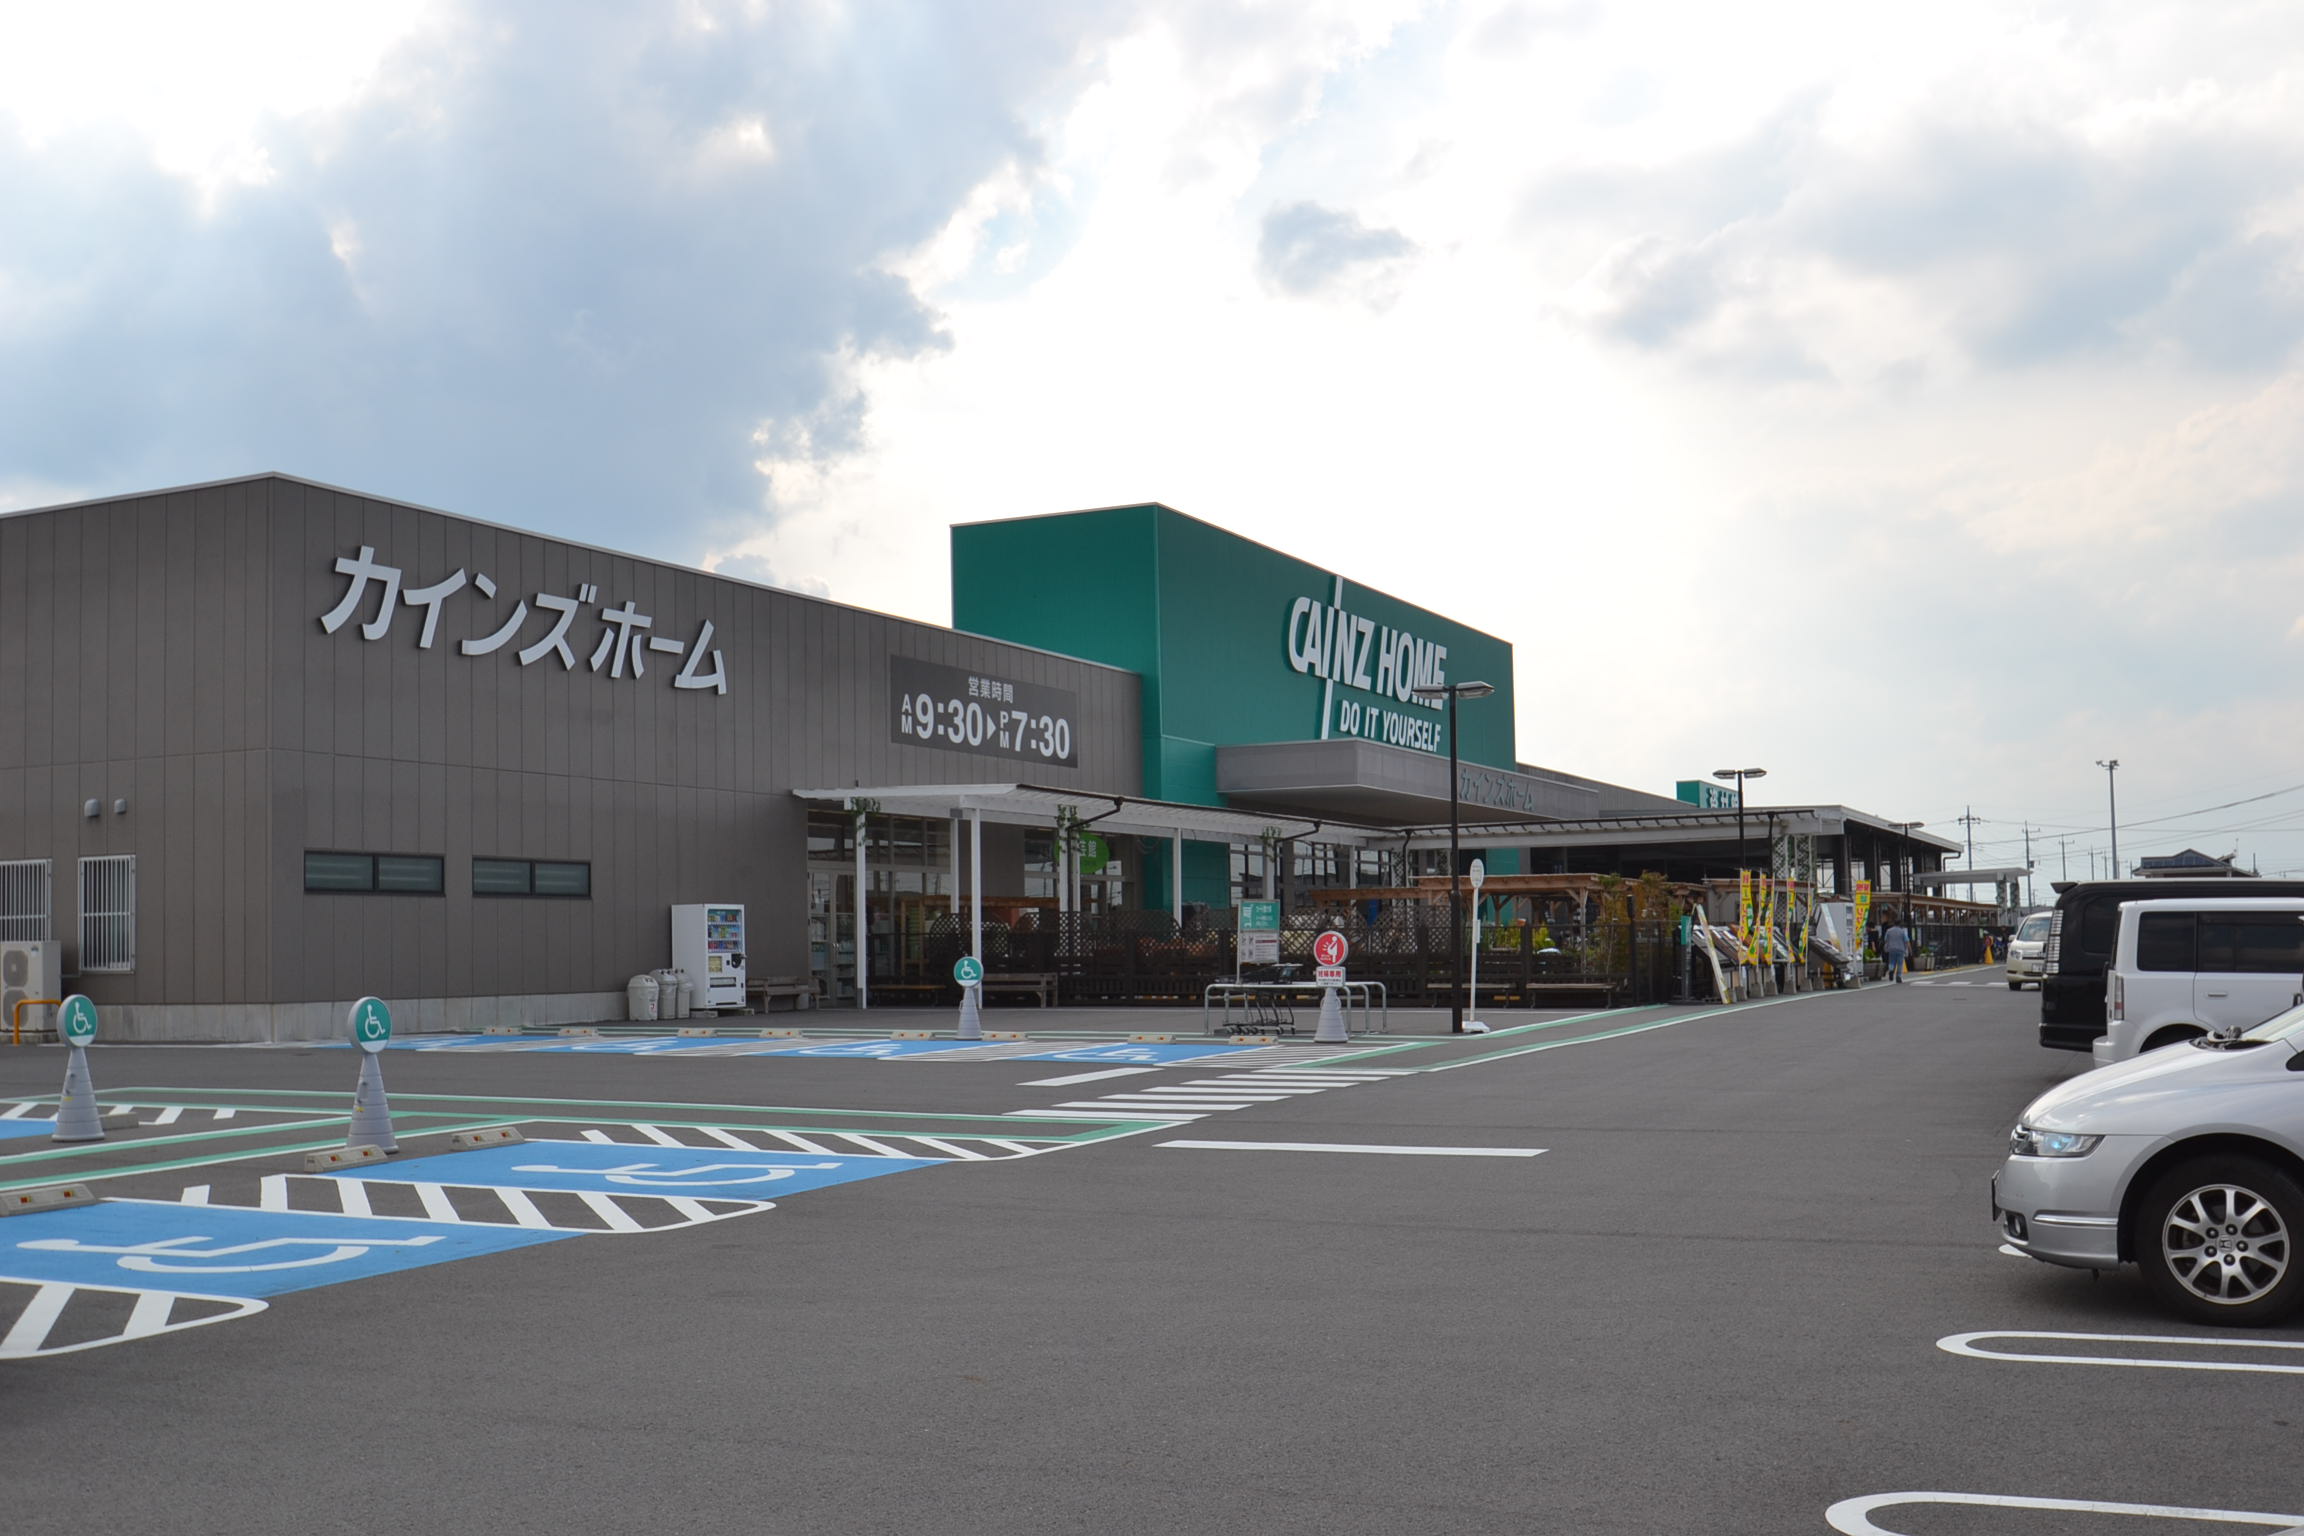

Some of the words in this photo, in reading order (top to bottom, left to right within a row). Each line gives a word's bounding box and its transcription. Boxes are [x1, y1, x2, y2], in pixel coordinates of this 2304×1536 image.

[319, 545, 728, 696] カインズホーム
[1288, 597, 1375, 690] CAINZ
[1376, 625, 1447, 711] HOME
[968, 676, 1014, 704] 営業時間
[915, 693, 983, 746] 9:30
[1011, 710, 1071, 760] 7:30
[1340, 699, 1360, 736] DO
[1364, 706, 1379, 739] IT
[1383, 711, 1441, 752] YOURSELF
[1460, 770, 1535, 810] カインズホーム
